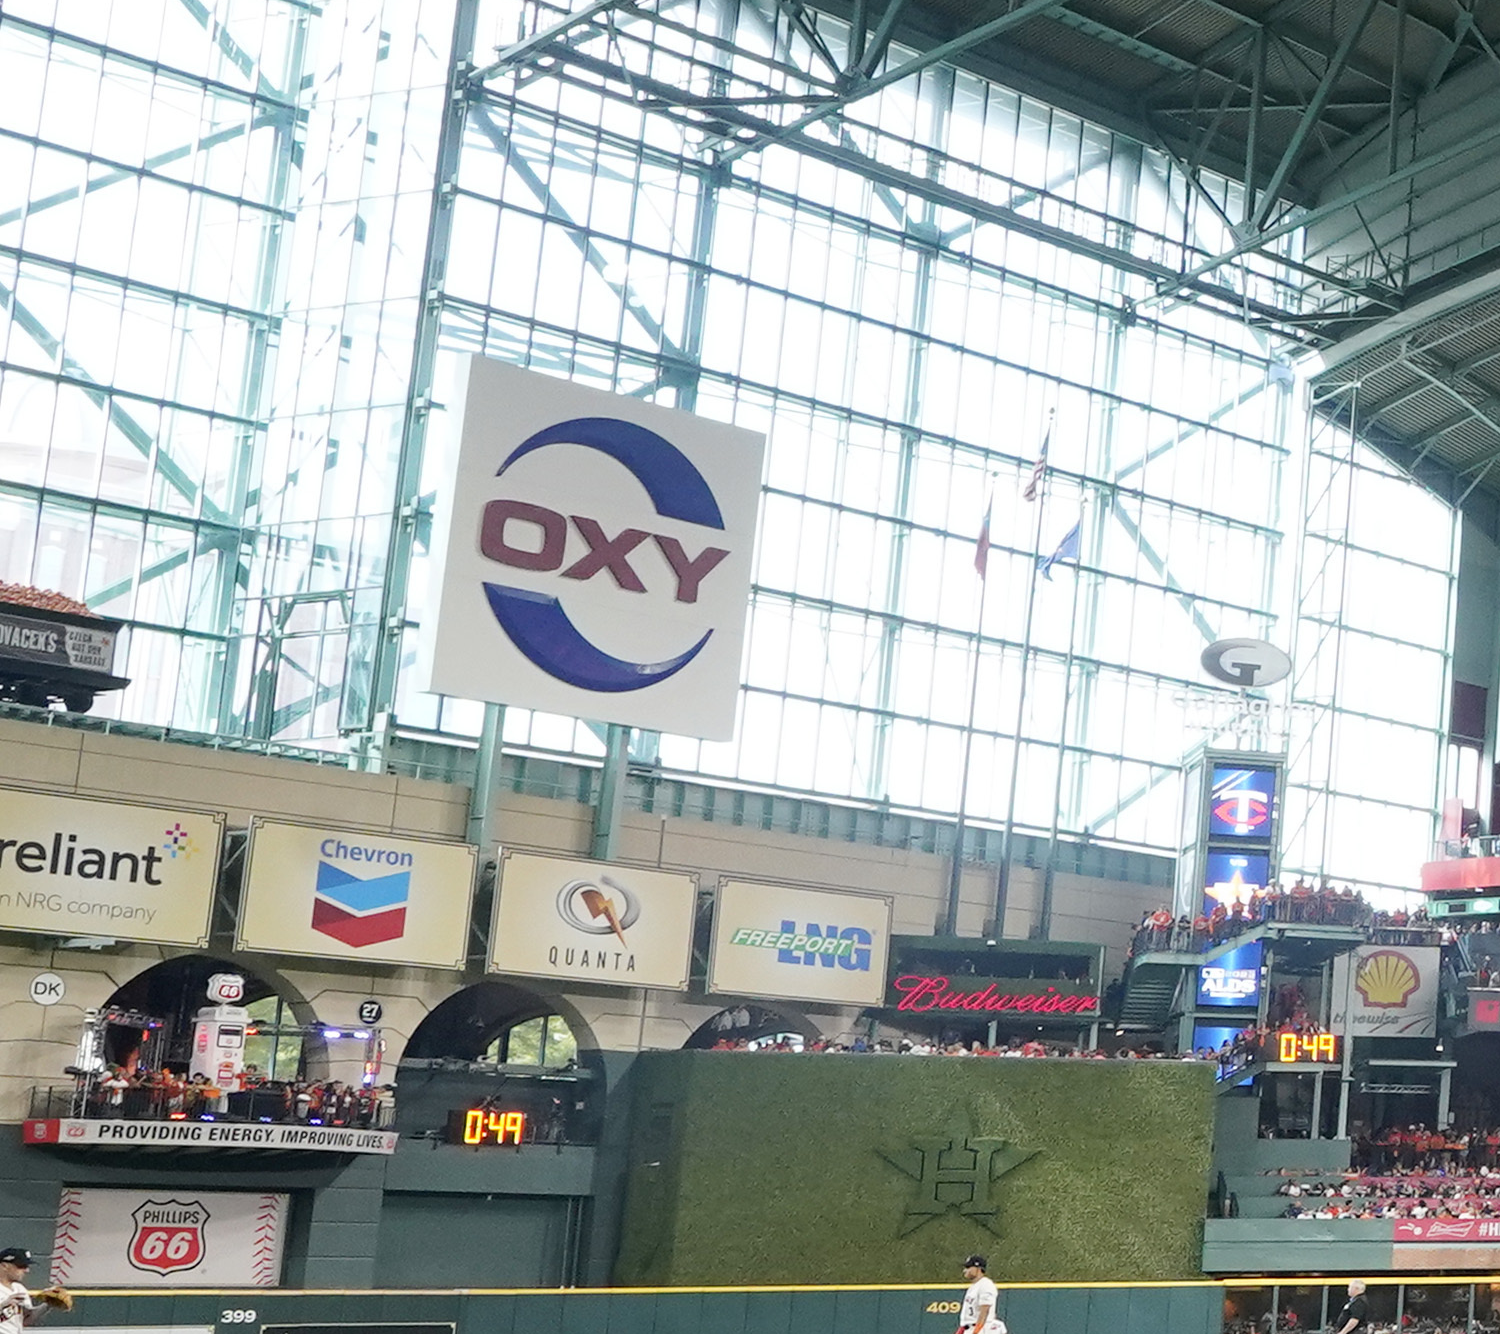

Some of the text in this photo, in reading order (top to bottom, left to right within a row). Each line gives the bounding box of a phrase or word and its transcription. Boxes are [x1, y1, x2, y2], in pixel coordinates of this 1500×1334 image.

[480, 499, 731, 604] OXY
[0, 833, 162, 886] reliant
[320, 837, 414, 867] Chevron
[16, 892, 158, 924] NRG company
[730, 924, 855, 956] FREEPORT
[777, 919, 873, 973] LNG
[549, 946, 638, 974] QUANTA
[33, 982, 62, 997] DK
[894, 974, 1099, 1014] Budweiser
[1201, 978, 1258, 995] ALDS
[361, 1004, 380, 1017] 27
[1279, 1033, 1336, 1063] 0:49
[99, 1124, 385, 1150] PROVIDING ENERGY. IMPROVING LIVES.
[463, 1110, 523, 1145] 0:49
[142, 1210, 201, 1225] PHILLIPS
[141, 1231, 193, 1261] 66
[220, 1310, 257, 1323] 399
[926, 1301, 961, 1313] 409
